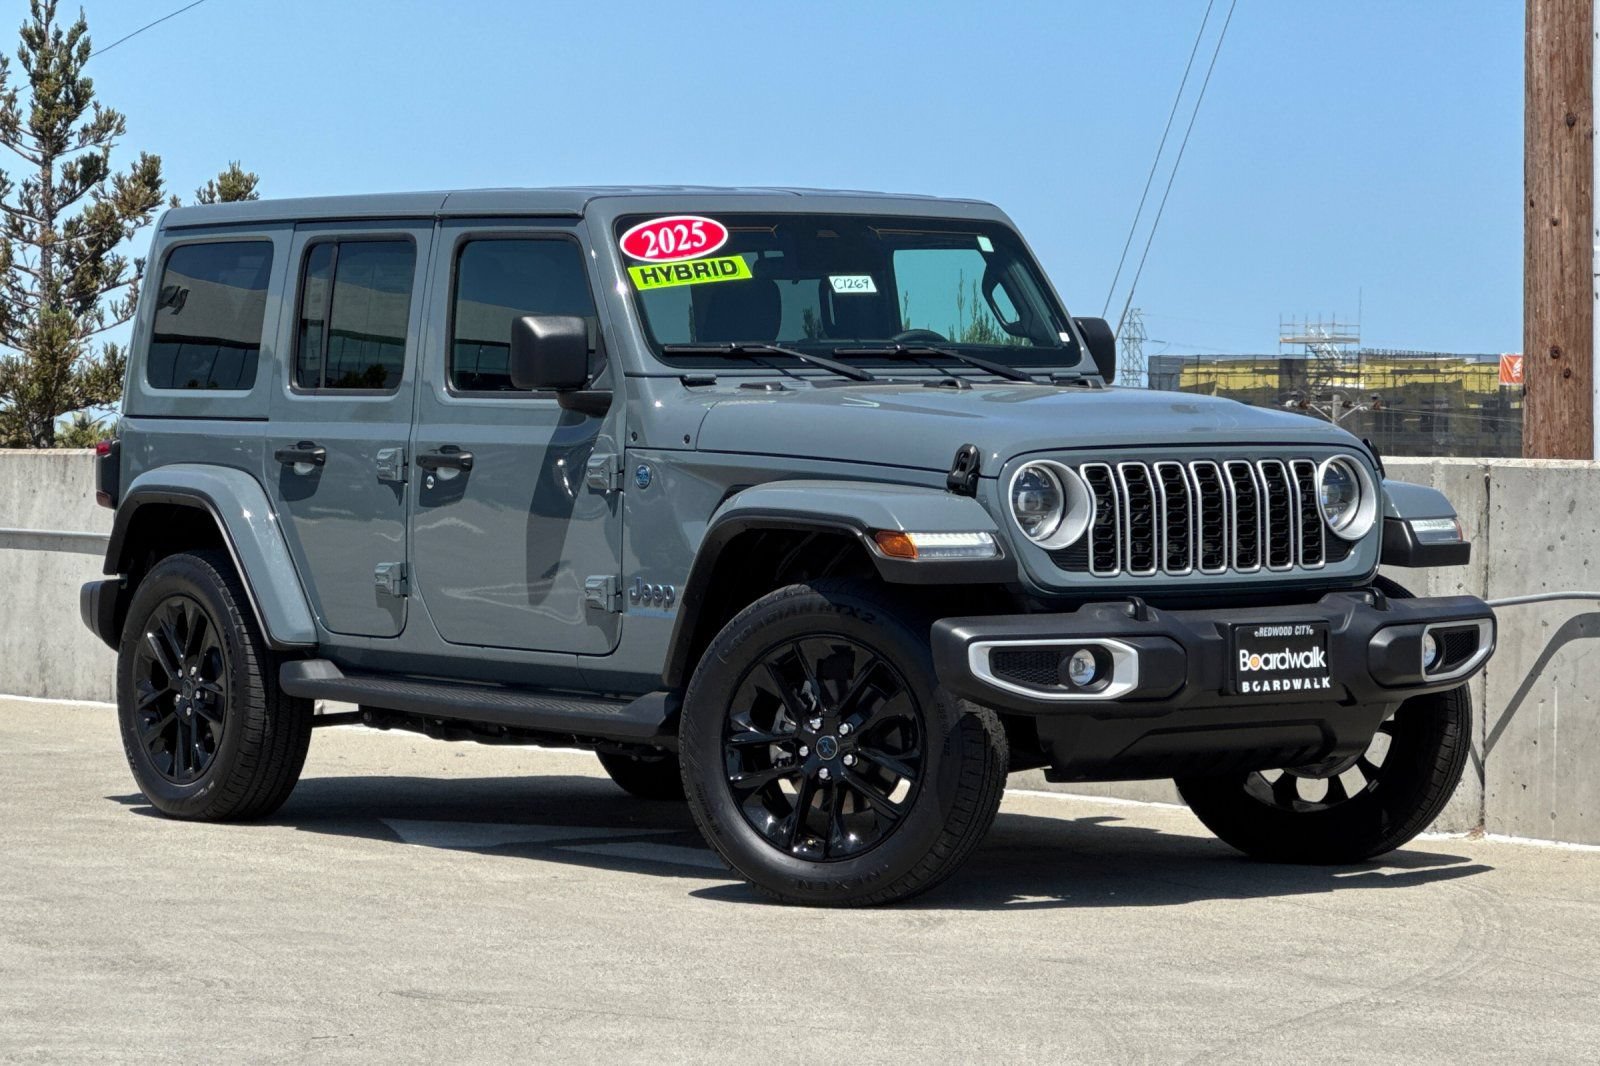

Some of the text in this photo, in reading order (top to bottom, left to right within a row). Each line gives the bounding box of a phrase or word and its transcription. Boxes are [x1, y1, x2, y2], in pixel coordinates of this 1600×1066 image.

[642, 222, 707, 258] 2025
[639, 259, 741, 285] HYBRID
[833, 278, 869, 290] C1269
[629, 577, 675, 610] Jeep
[1259, 625, 1311, 637] REDWOOD CITY
[1239, 646, 1327, 671] Boardwalk
